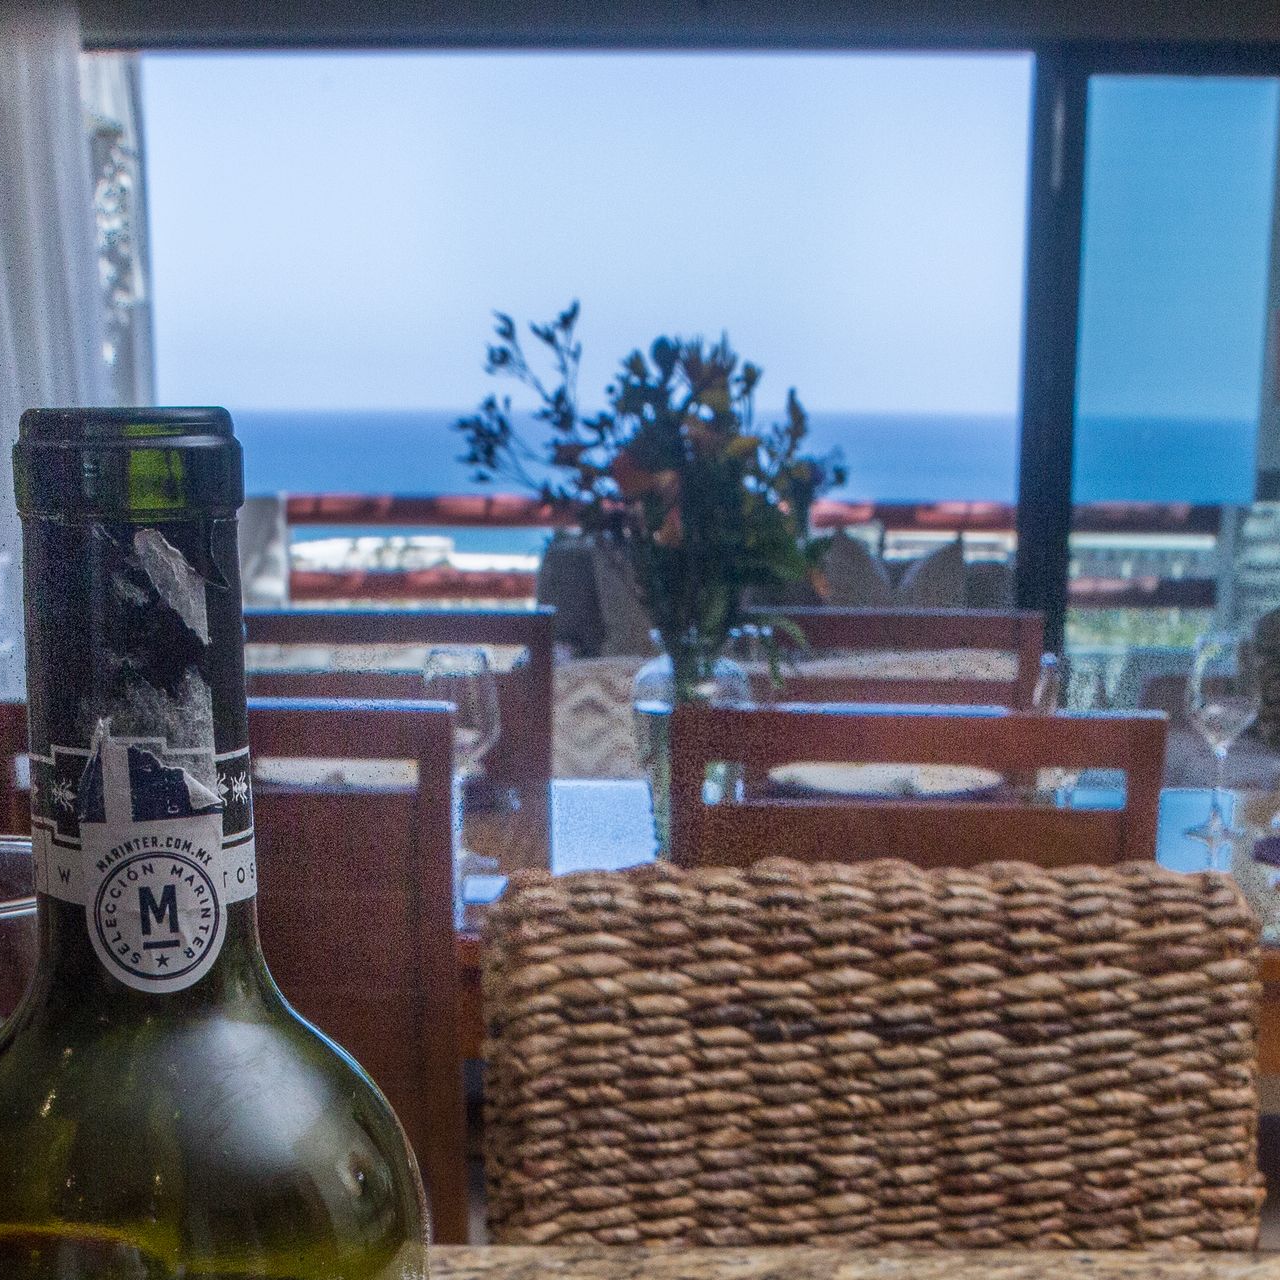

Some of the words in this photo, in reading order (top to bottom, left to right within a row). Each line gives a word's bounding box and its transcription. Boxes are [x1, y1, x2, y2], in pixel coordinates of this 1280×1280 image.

[96, 836, 212, 873] MARINTER.COM.MX
[105, 863, 155, 965] SELECCIÓN
[170, 864, 211, 959] MARINTER
[138, 884, 180, 936] M
